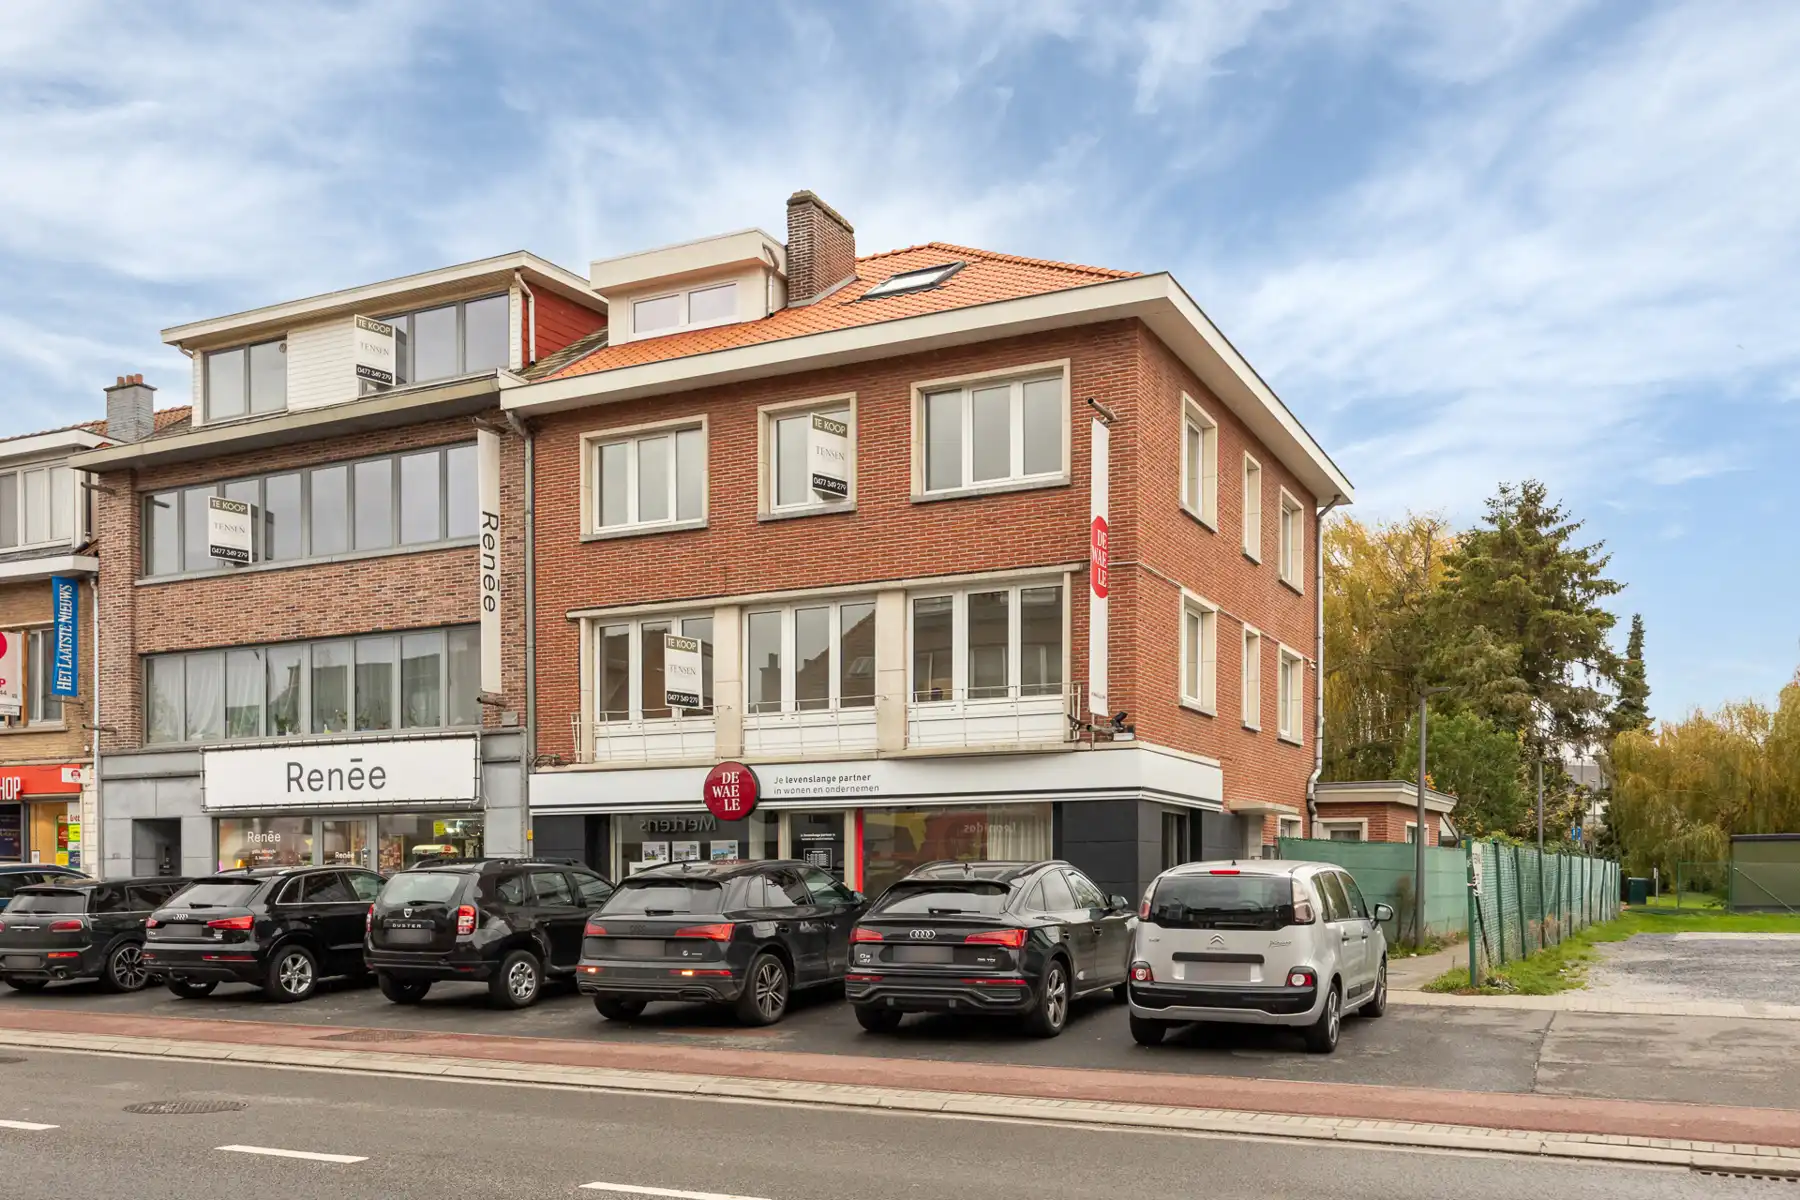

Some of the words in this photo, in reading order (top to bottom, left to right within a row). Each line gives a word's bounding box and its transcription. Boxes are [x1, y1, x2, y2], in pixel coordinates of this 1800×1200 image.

[358, 319, 366, 328] TE
[368, 322, 390, 334] KOOP
[360, 341, 389, 356] TENSEN
[357, 366, 371, 375] 0477
[382, 373, 392, 381] 279
[814, 418, 822, 428] TE
[824, 421, 846, 434] KOOP
[816, 445, 845, 461] TENSEN
[813, 476, 826, 487] 0477
[827, 481, 836, 489] 349
[212, 500, 220, 508] TE
[222, 502, 246, 512] KOOP
[214, 521, 245, 534] TENSEN
[1097, 529, 1107, 550] DE
[211, 546, 225, 554] 0477
[1097, 567, 1107, 588] LE
[58, 584, 73, 624] NIEUWS
[57, 624, 73, 669] LAATSTE
[668, 638, 675, 647] TE
[676, 640, 697, 650] KOOP
[668, 664, 697, 676] TENSEN
[56, 669, 72, 691] HET
[721, 771, 740, 785] DE
[773, 776, 784, 785] Je
[785, 775, 837, 785] levenslange
[838, 774, 872, 783] partner
[712, 785, 740, 798] WAE
[783, 787, 811, 795] wonen
[812, 786, 823, 794] en
[825, 784, 880, 793] ondernemen
[724, 799, 740, 811] LE
